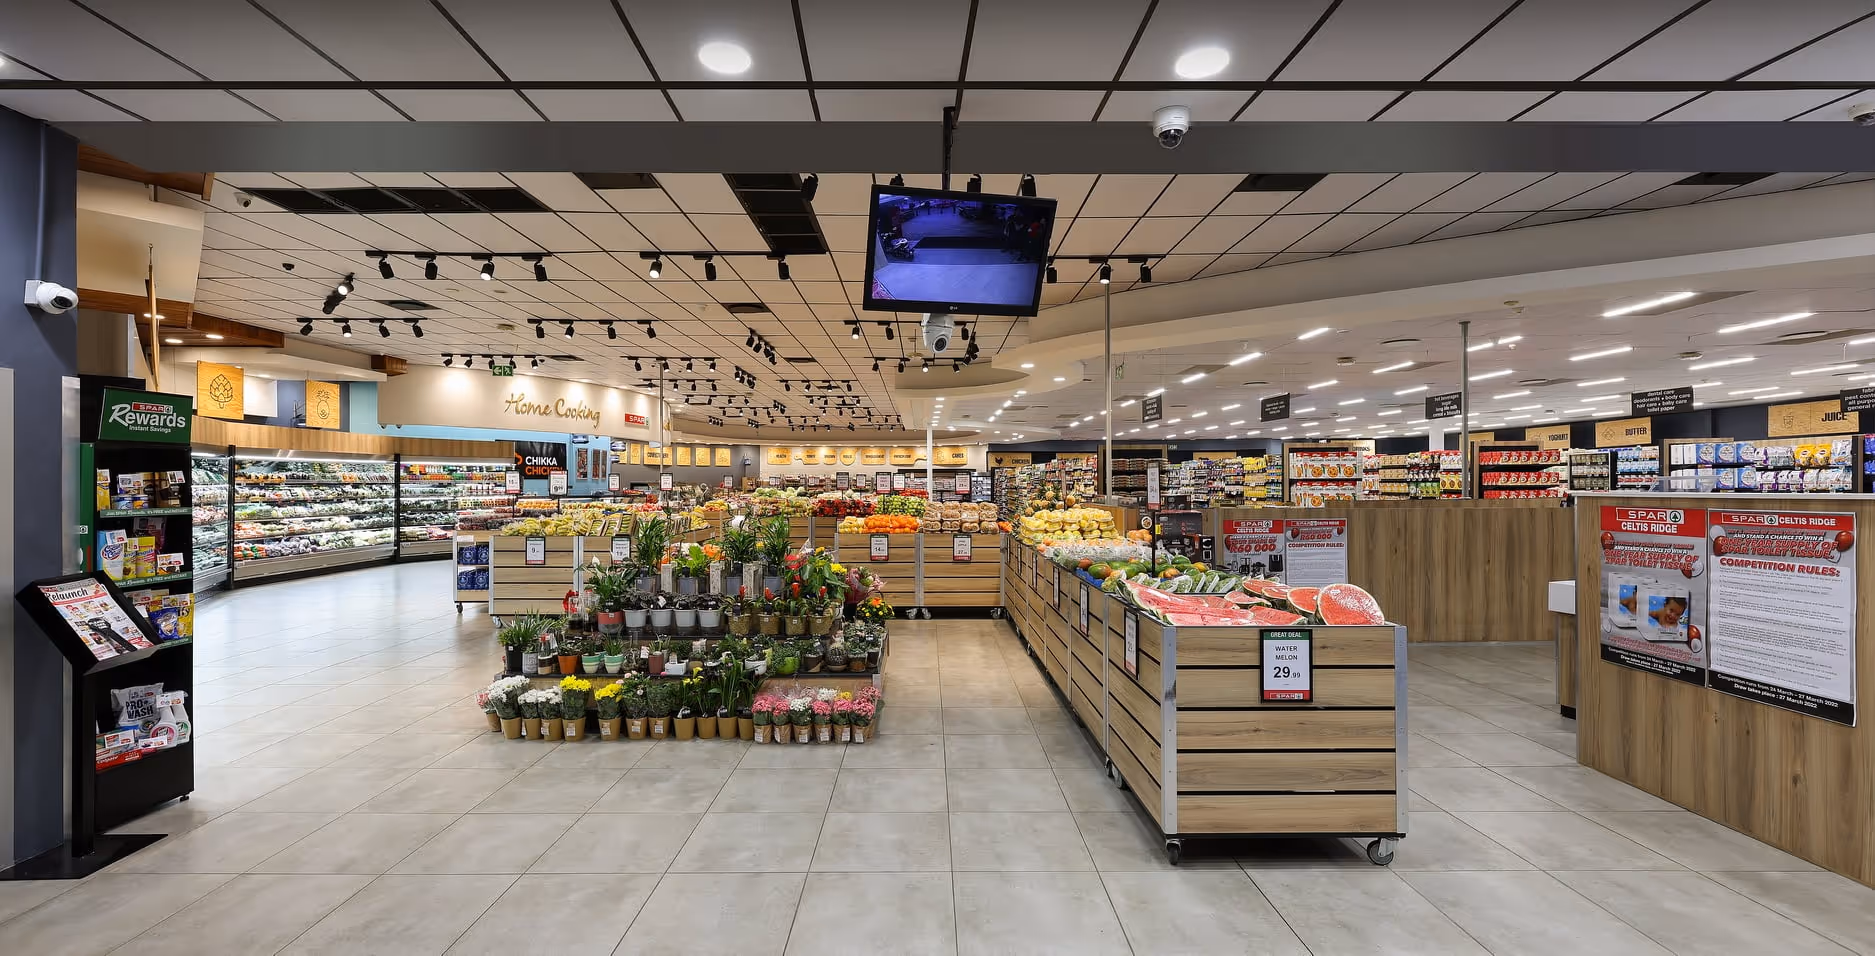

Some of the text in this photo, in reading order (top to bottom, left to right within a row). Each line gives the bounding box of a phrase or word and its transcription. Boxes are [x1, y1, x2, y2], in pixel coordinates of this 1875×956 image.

[109, 404, 186, 428] Rewards
[505, 393, 601, 428] Home Cooking
[1821, 412, 1847, 422] JUICE
[1625, 427, 1647, 436] BUTTER
[525, 456, 558, 466] CHIKKA
[1628, 511, 1666, 520] SPAR
[1622, 522, 1678, 533] CELTIS RIDGE
[1720, 539, 1839, 550] ONE-YEAR SUPPLY OF
[1604, 549, 1699, 563] ONE-YEAR SUPPLY OF
[1721, 546, 1750, 554] SPAR
[1751, 547, 1789, 556] TOILET
[1605, 557, 1628, 566] SPAR
[1629, 559, 1659, 568] TOILET
[1720, 558, 1841, 577] COMPETITION RULES:
[44, 588, 88, 602] Relaunch
[1718, 673, 1745, 684] Competition
[1777, 687, 1793, 696] March
[1806, 694, 1824, 704] March
[1824, 700, 1838, 708] 2022
[1747, 686, 1760, 694] takes
[1762, 690, 1776, 698] place
[1786, 696, 1803, 705] March
[126, 700, 143, 710] PRO
[127, 705, 153, 719] WASH
